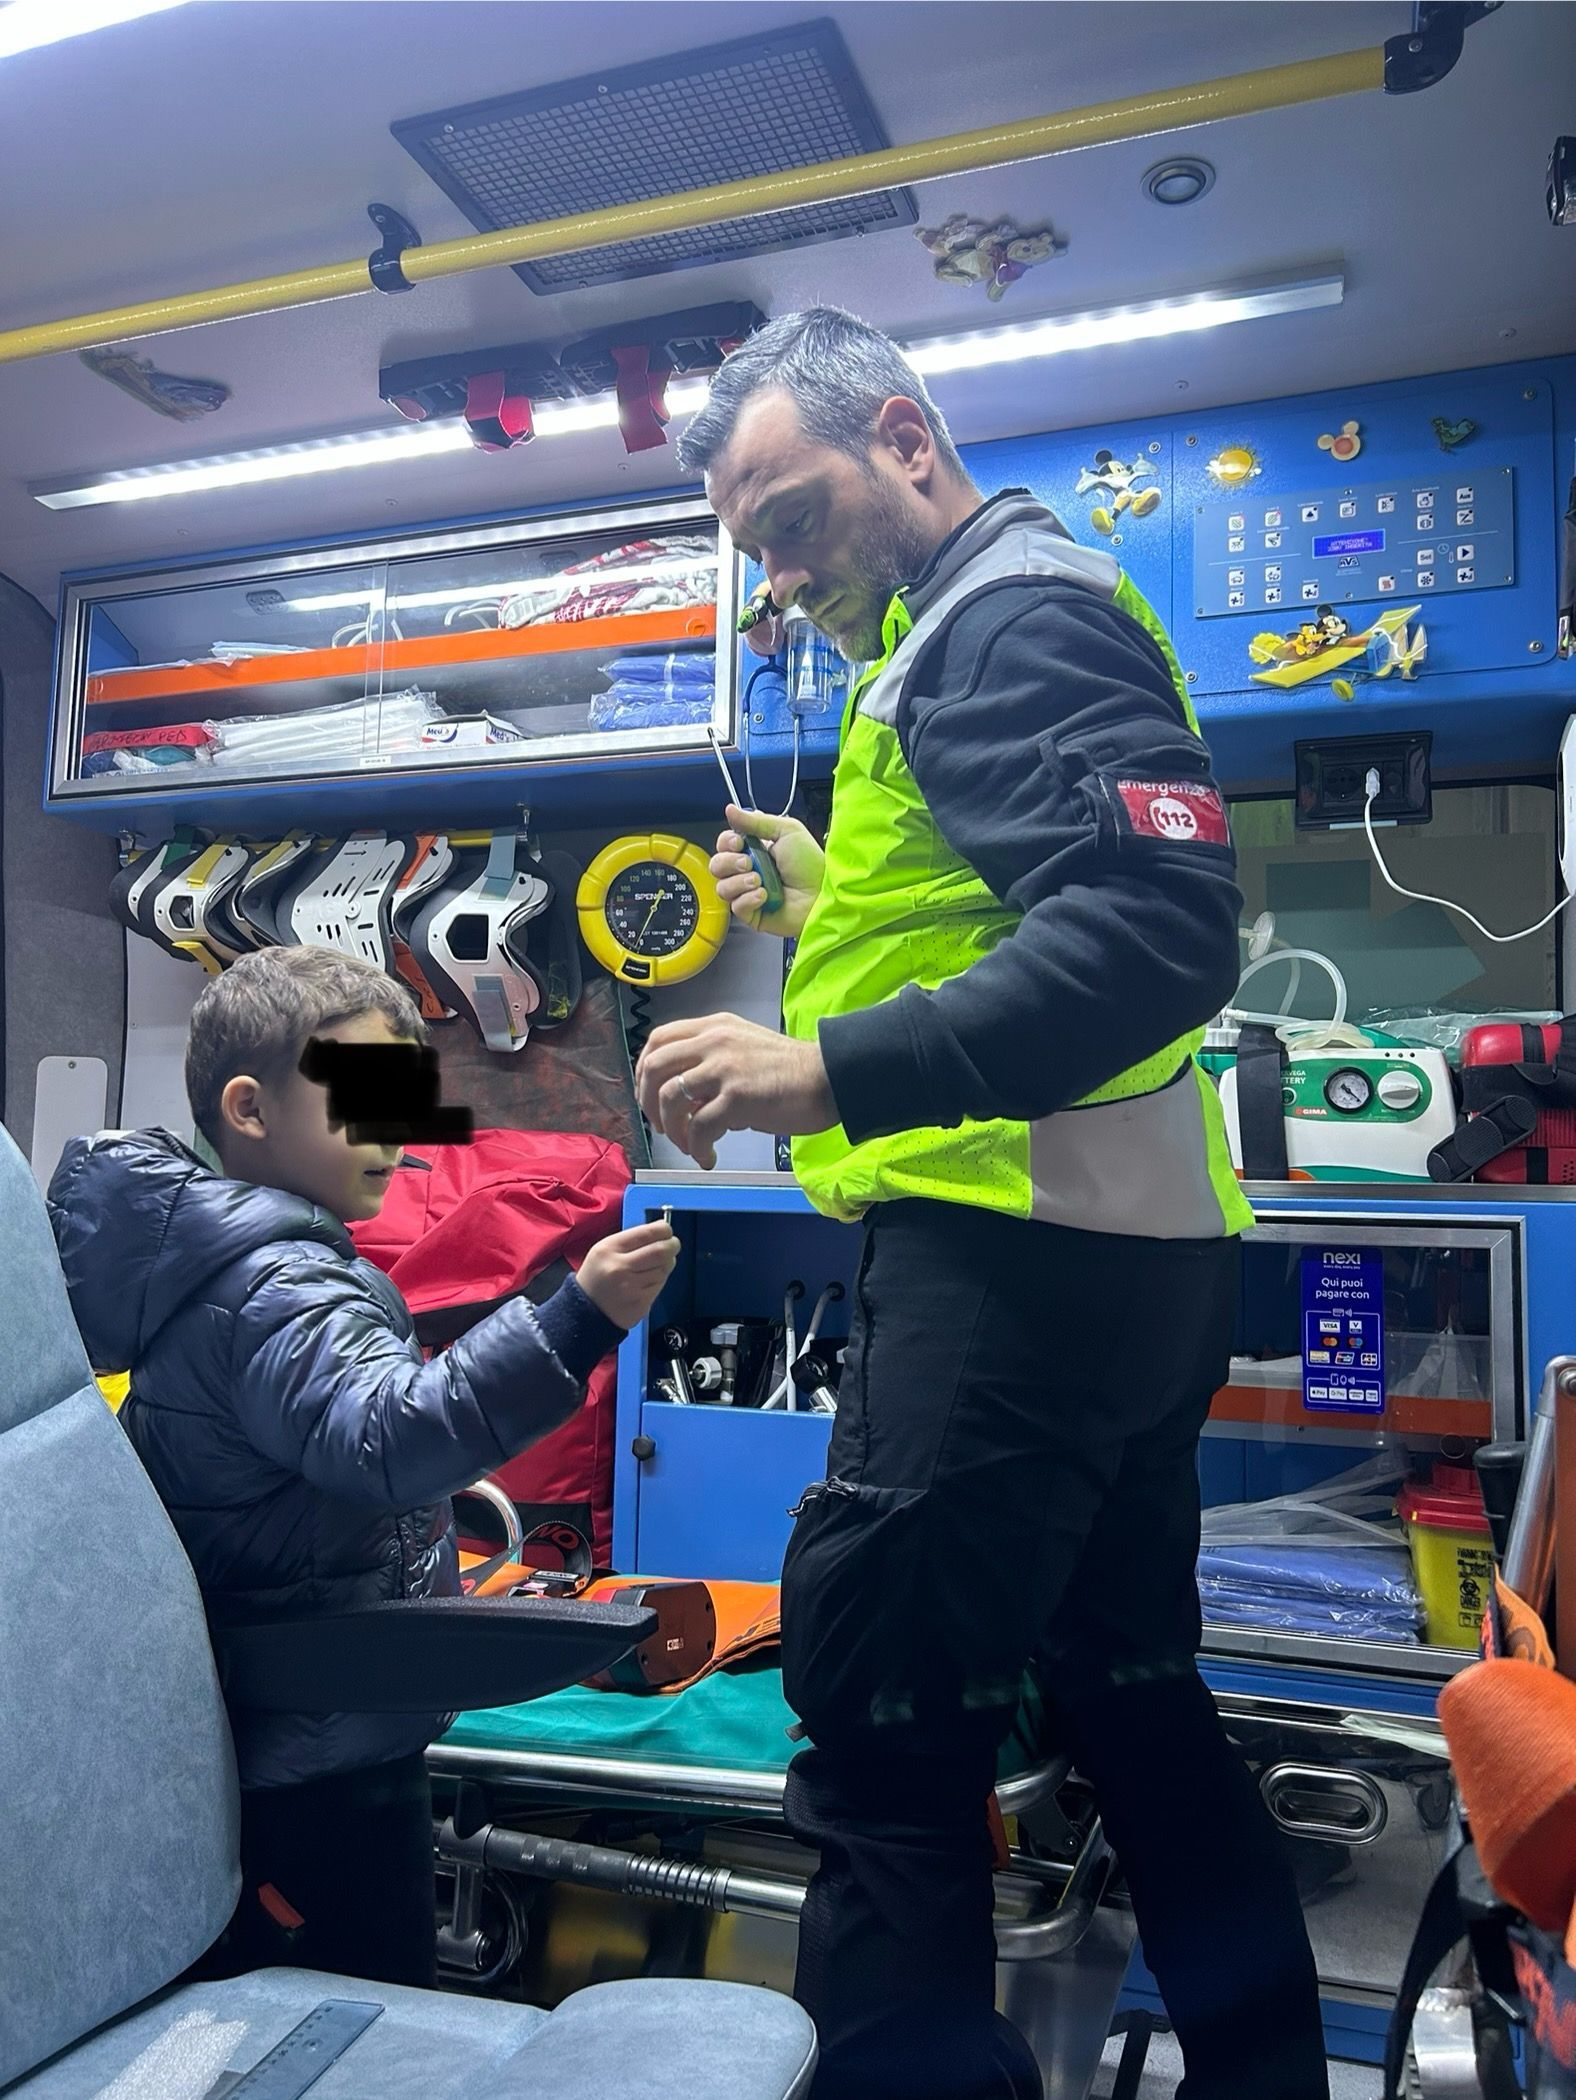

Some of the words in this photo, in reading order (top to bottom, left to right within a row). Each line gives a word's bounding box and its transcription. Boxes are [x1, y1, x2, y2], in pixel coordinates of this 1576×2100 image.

[1160, 812, 1194, 828] 112
[682, 908, 694, 916] 240
[619, 920, 628, 928] 40
[627, 930, 636, 938] 20
[663, 938, 676, 946] 300
[1321, 1277, 1339, 1288] Qui
[1341, 1278, 1364, 1289] puoi
[1315, 1290, 1349, 1300] pagare
[1351, 1291, 1370, 1300] con
